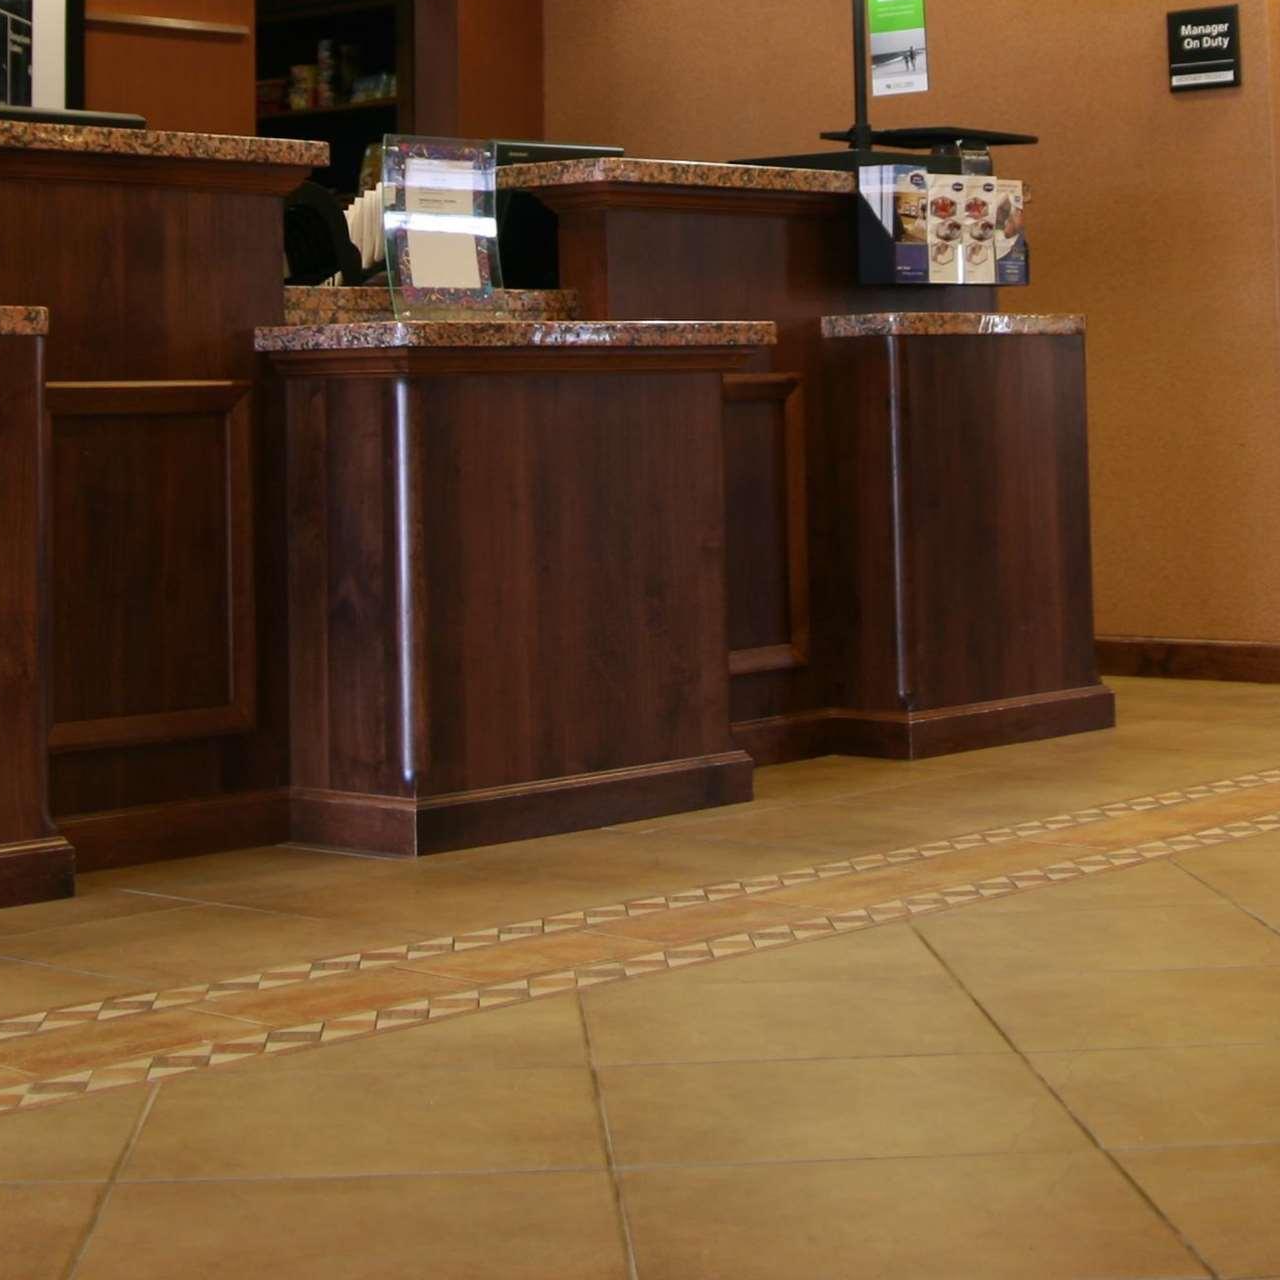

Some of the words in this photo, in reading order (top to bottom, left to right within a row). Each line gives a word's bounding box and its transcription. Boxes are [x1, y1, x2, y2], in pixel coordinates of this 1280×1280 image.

[1180, 22, 1229, 36] Manager
[1183, 38, 1200, 50] On
[1202, 35, 1230, 49] Duty
